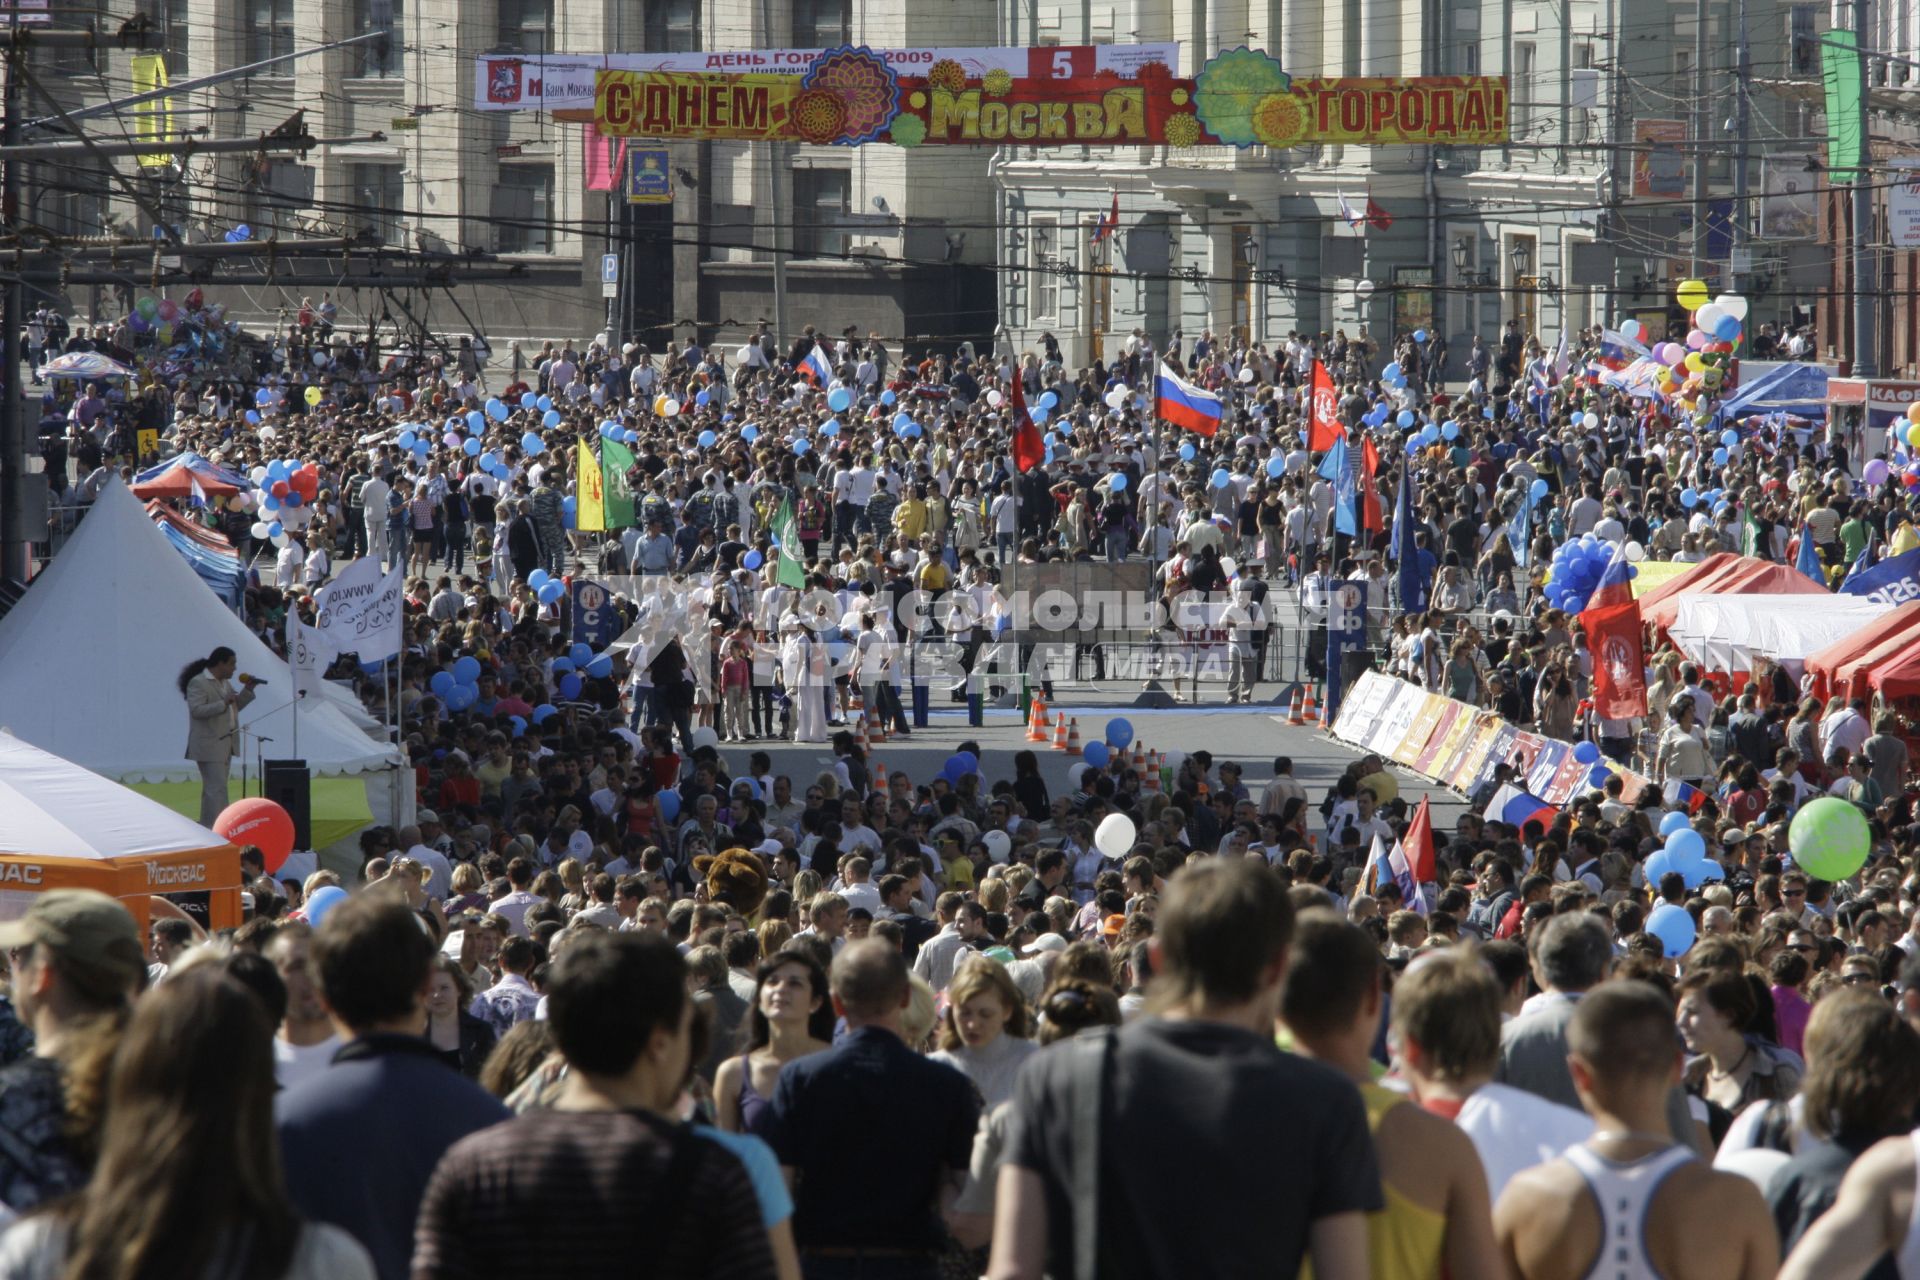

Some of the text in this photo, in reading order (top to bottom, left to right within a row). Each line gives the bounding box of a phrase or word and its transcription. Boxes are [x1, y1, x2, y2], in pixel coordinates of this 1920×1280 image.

[706, 53, 766, 69] ДЕНЬ
[886, 51, 934, 64] 2009
[1051, 51, 1073, 79] 5
[545, 83, 565, 97] Банк
[605, 82, 633, 126] С
[1316, 88, 1504, 138] ГОРОДА!
[606, 258, 615, 279] P
